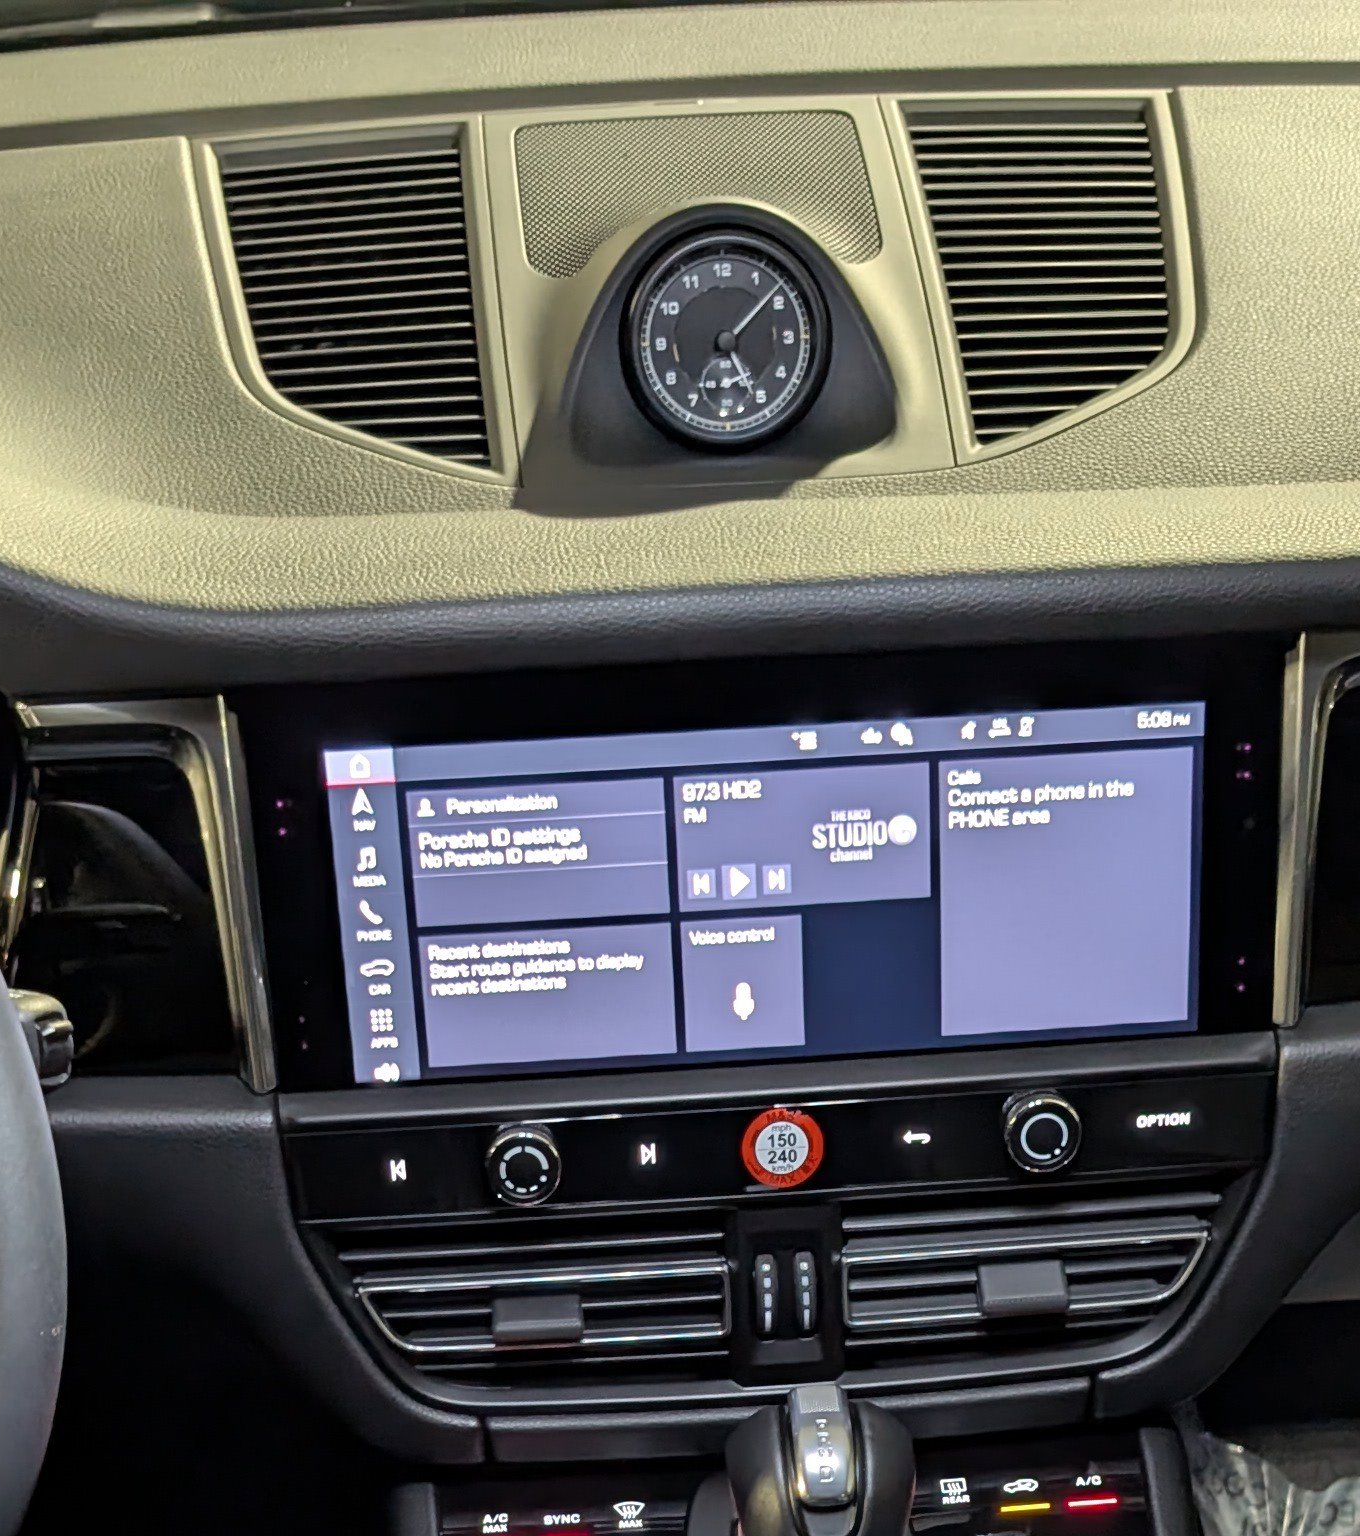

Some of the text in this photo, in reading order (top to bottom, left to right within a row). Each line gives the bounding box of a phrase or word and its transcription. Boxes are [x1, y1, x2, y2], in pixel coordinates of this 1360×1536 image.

[713, 263, 732, 278] 12
[682, 275, 699, 289] 11
[751, 271, 760, 286] 1
[660, 301, 680, 316] 10
[773, 295, 785, 310] 2
[655, 337, 667, 351] 9
[783, 330, 795, 345] 3
[665, 372, 677, 386] 8
[775, 365, 787, 380] 4
[688, 393, 699, 408] 7
[756, 390, 767, 404] 5
[1136, 710, 1191, 729] 5:08 PM
[723, 779, 762, 800] HD2
[947, 779, 1135, 807] Connect a phone in the
[446, 793, 558, 815] Personalization
[683, 807, 708, 824] FM
[947, 808, 1050, 829] PHONE area
[353, 819, 376, 832] NAV
[418, 825, 581, 851] Porsche ID settings
[812, 820, 888, 850] STUDIO
[420, 844, 587, 869] No Porsche ID assigned
[830, 846, 873, 863] channel
[352, 874, 387, 888] MEDIA
[356, 929, 393, 943] PHONE
[689, 926, 775, 946] Voice control
[428, 939, 571, 961] Recent destinations
[429, 952, 644, 980] Start route guidance to display
[368, 983, 391, 996] CAR
[431, 975, 567, 997] recent destinations
[370, 1036, 398, 1049] APPS
[1136, 1112, 1191, 1128] OPTION
[772, 1124, 792, 1133] mph
[767, 1133, 797, 1148] 150
[768, 1149, 798, 1164] 240
[1075, 1475, 1102, 1487] A/C
[942, 1494, 970, 1505] REAR
[483, 1512, 508, 1525] A/C
[544, 1513, 581, 1526] SYNC
[618, 1519, 643, 1529] MAX
[483, 1524, 508, 1534] MAX
